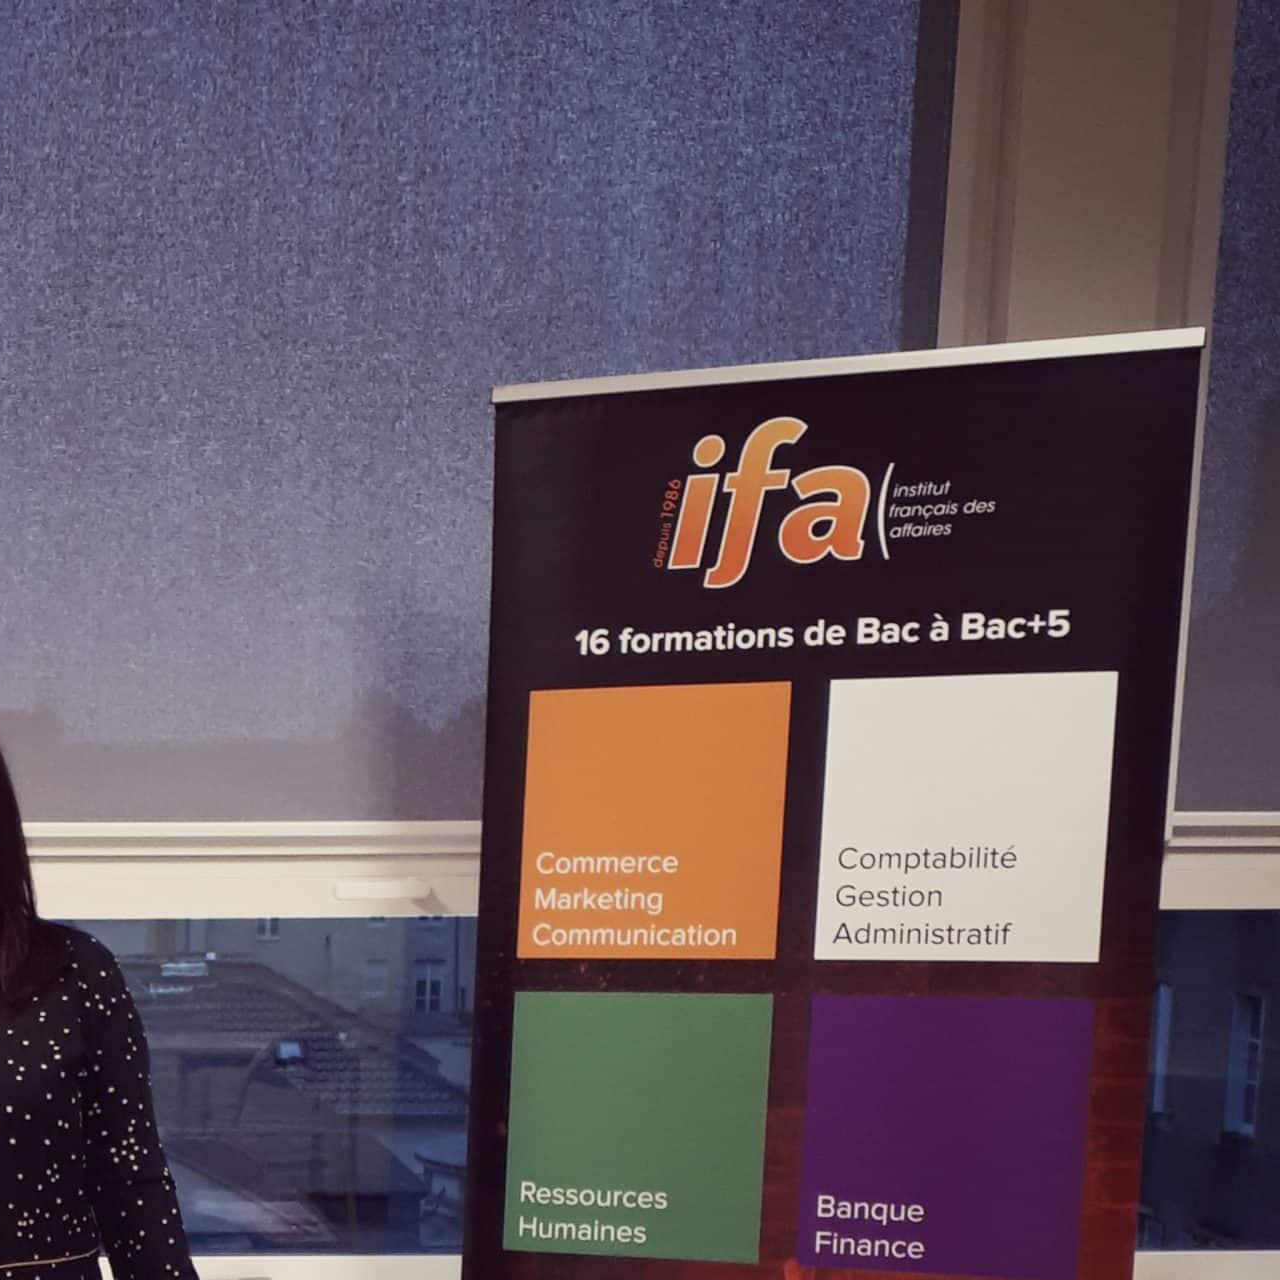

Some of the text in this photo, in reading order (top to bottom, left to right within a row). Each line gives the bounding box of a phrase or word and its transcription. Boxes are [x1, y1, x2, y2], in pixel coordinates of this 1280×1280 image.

[668, 416, 871, 589] ifa
[893, 481, 951, 498] institut
[889, 499, 995, 520] français des
[654, 479, 681, 569] depuis 1986
[889, 523, 952, 539] affaires
[576, 610, 1070, 656] 16 formations de Bac à Bac+5
[536, 851, 679, 876] Commerce
[838, 845, 1017, 875] Comptabilité
[535, 888, 664, 915] Marketing
[836, 885, 943, 908] Gestion
[532, 923, 737, 948] Communication
[832, 920, 1013, 946] Administratif
[520, 1181, 668, 1210] Ressources
[817, 1195, 925, 1227] Banque
[518, 1217, 647, 1245] Humaines
[815, 1232, 925, 1260] Finance
